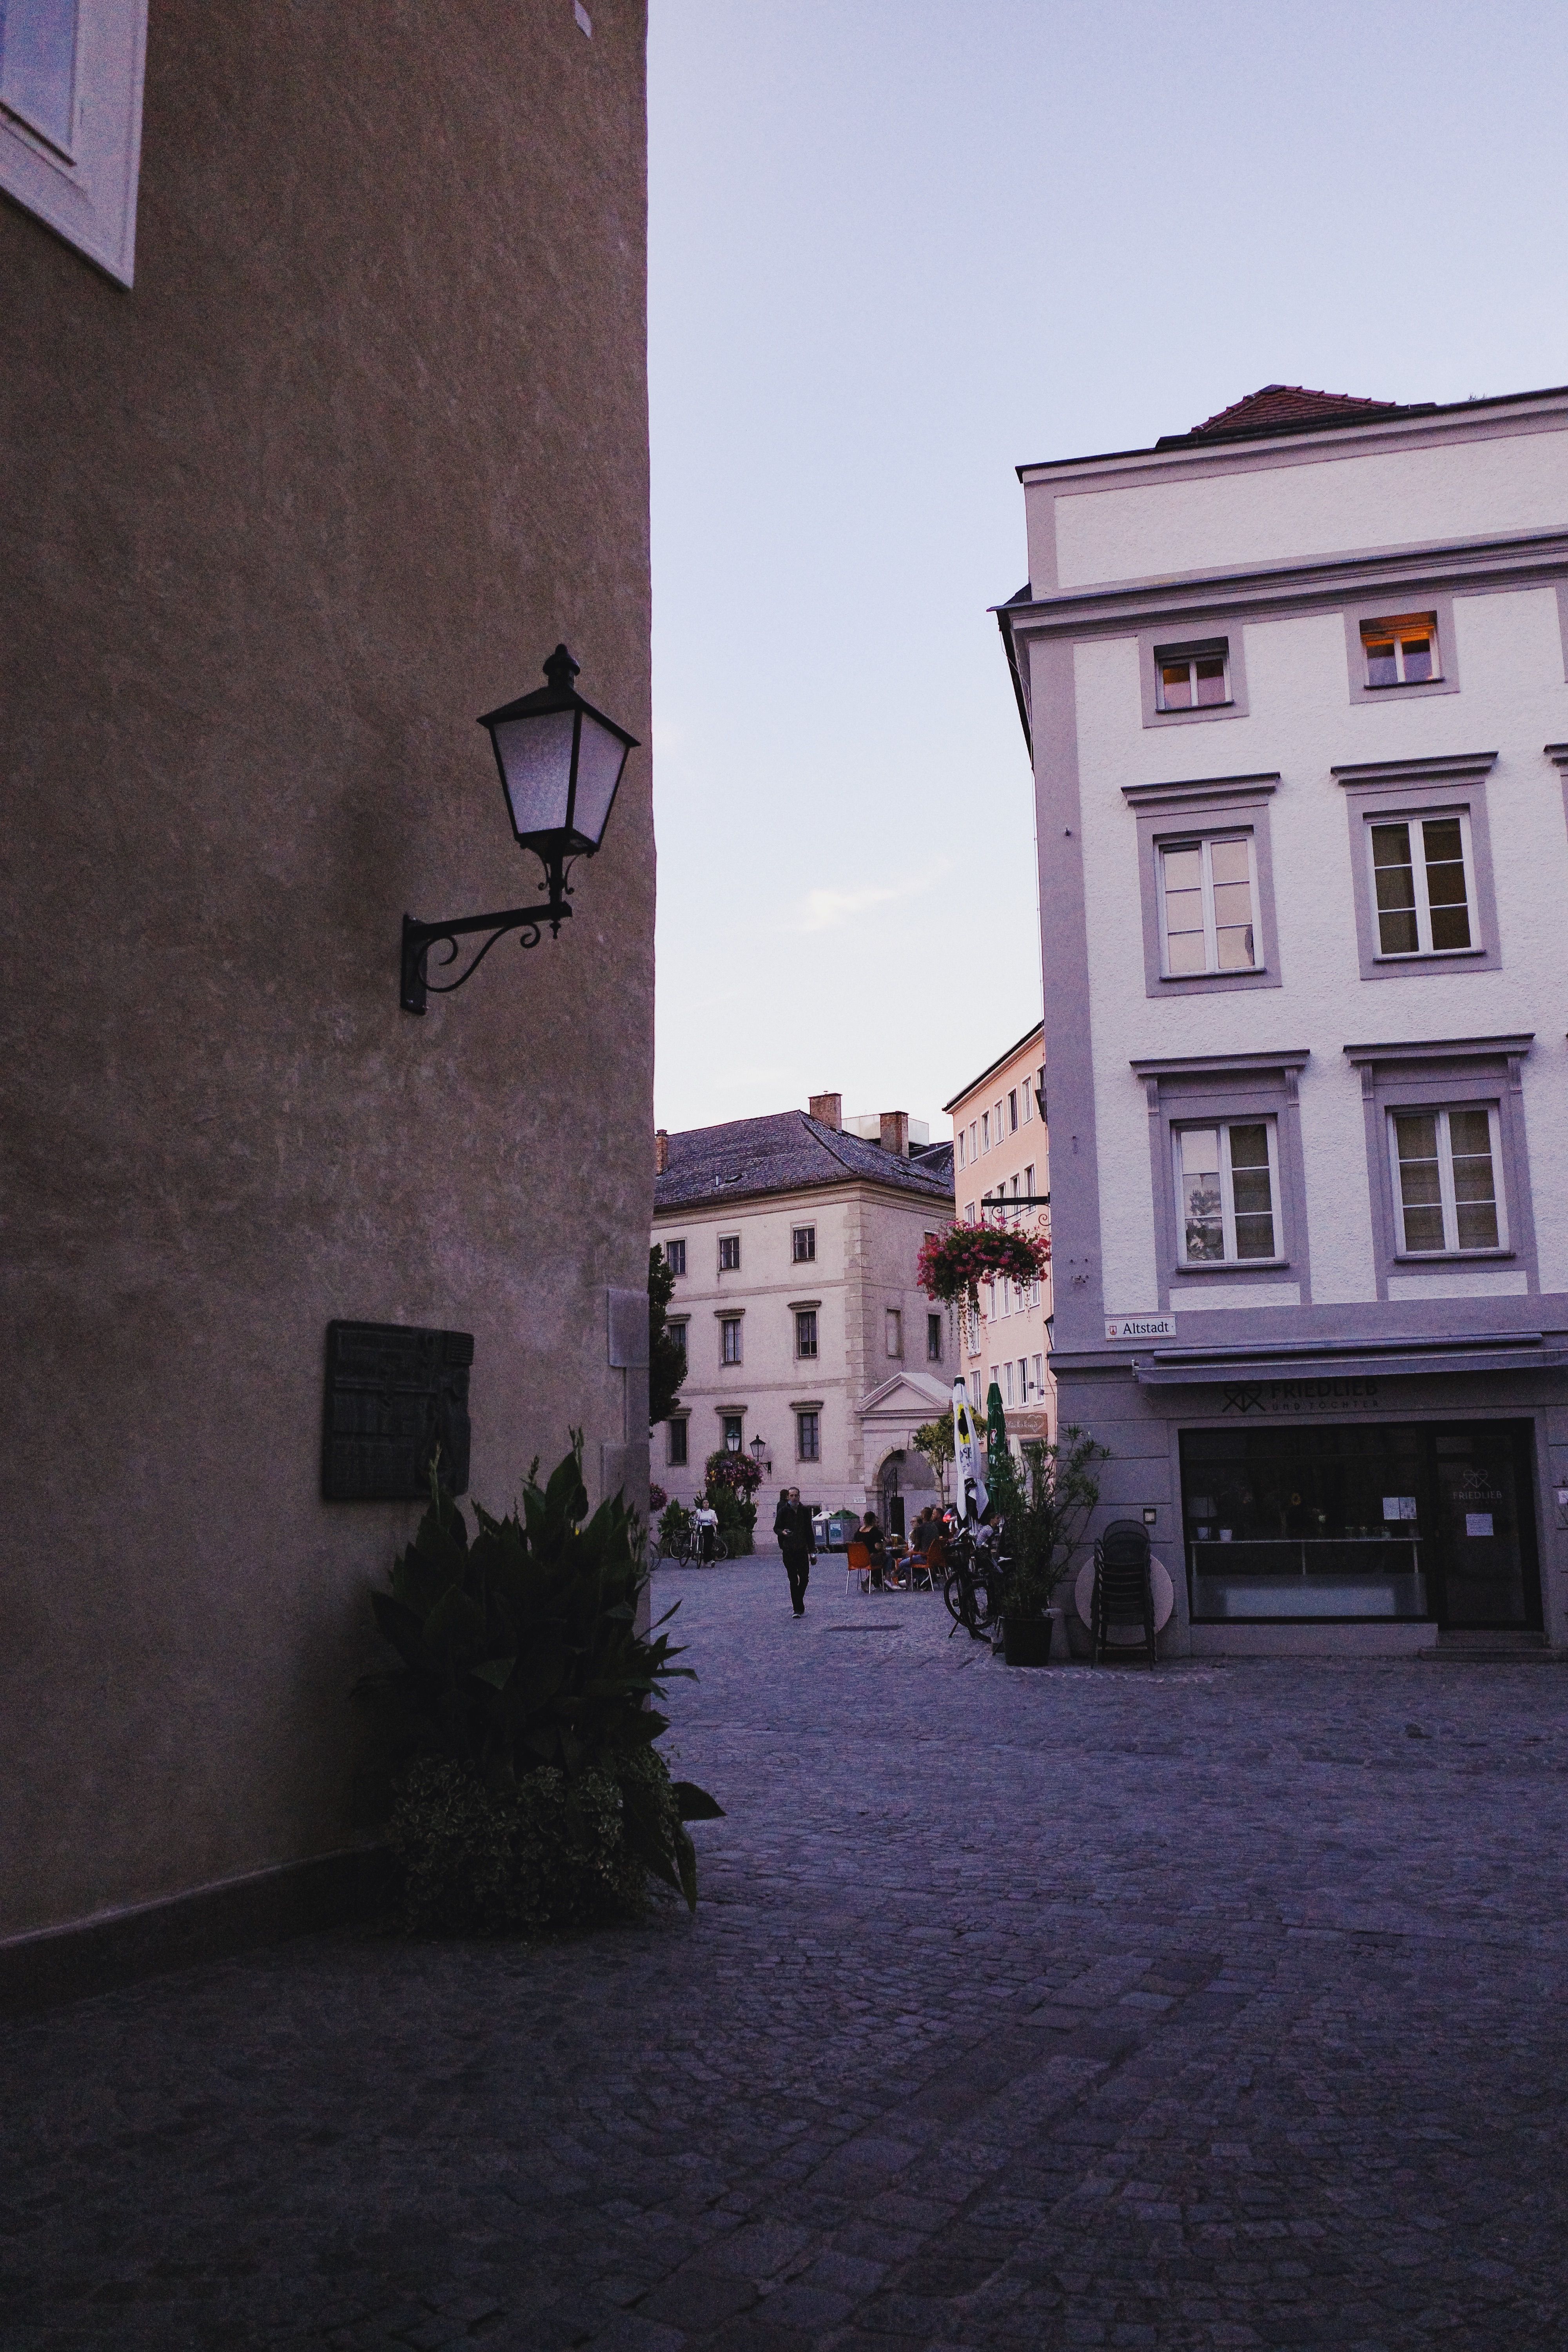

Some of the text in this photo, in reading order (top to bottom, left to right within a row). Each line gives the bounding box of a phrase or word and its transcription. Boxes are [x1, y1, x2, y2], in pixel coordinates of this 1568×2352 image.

[1122, 1321, 1170, 1334] Altstadt
[1271, 1378, 1377, 1399] FRIEDLIEB
[1453, 1491, 1502, 1499] FRIEDLIEB
